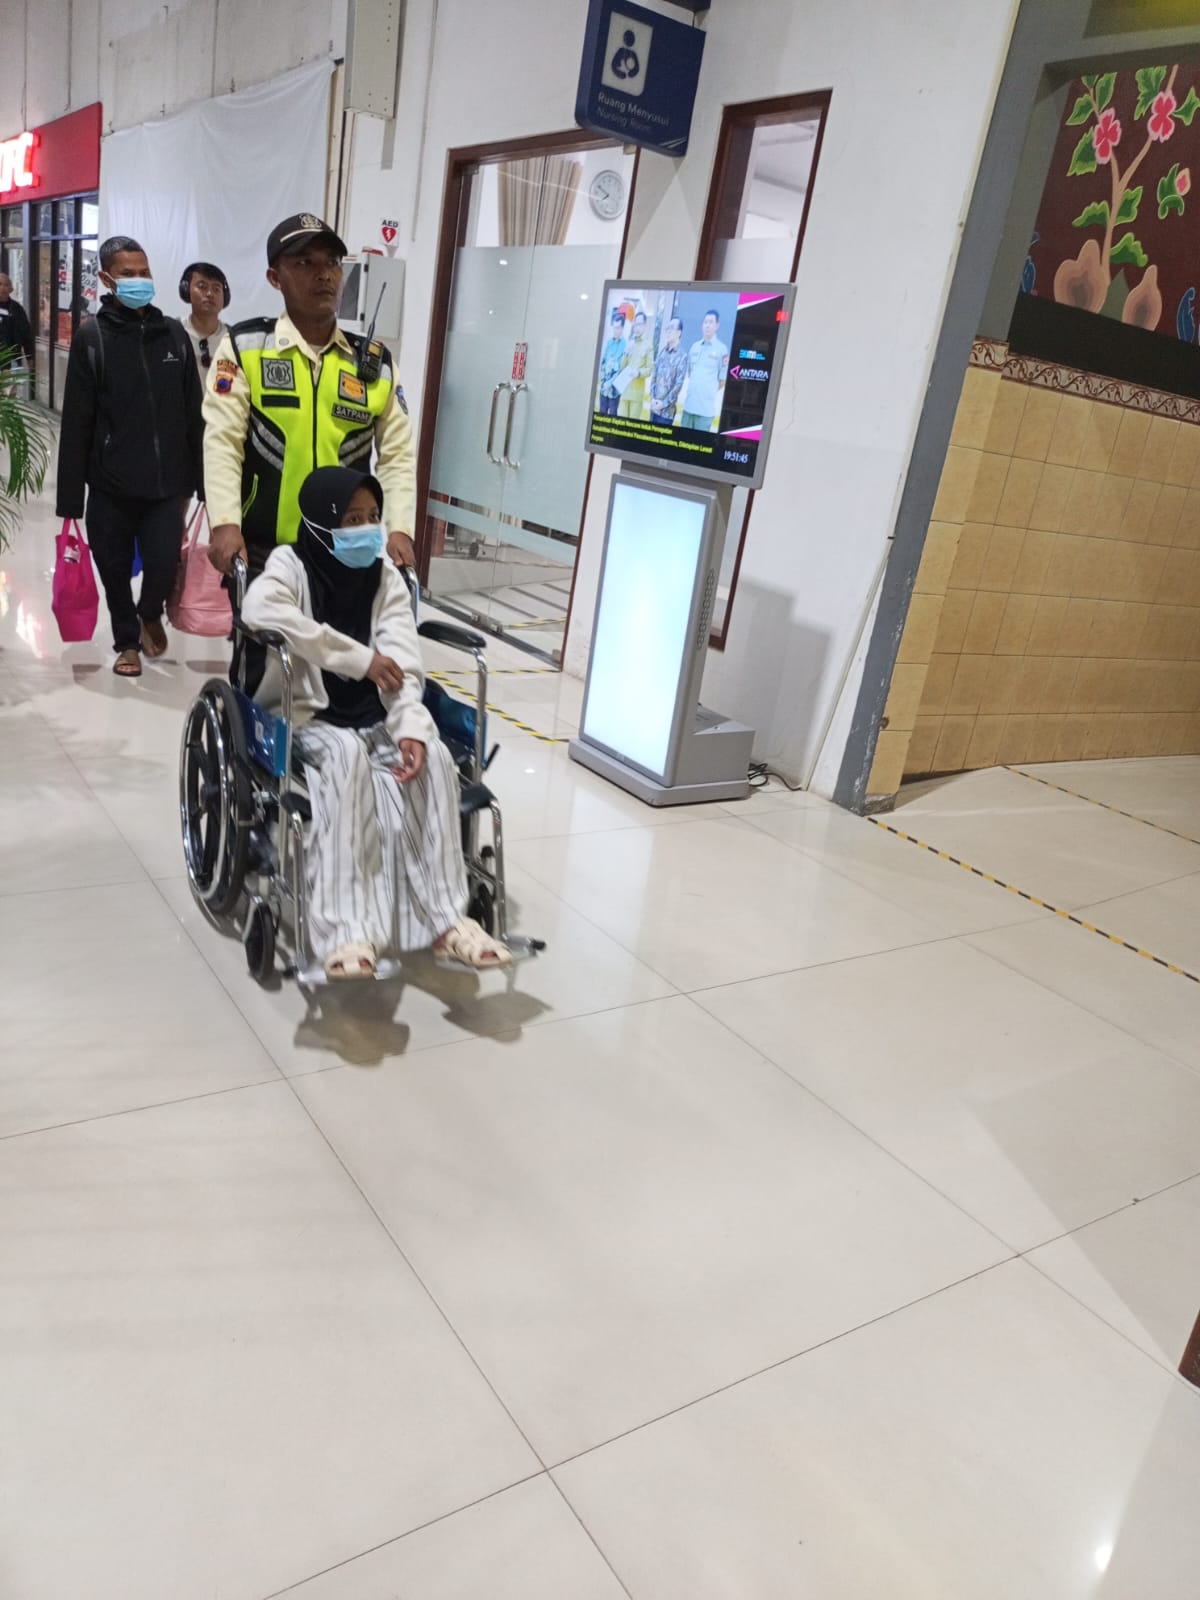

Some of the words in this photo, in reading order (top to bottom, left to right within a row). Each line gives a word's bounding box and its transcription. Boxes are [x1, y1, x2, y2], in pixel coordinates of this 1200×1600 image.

[598, 91, 626, 113] Ruang
[627, 102, 670, 127] Menyusui
[0, 131, 37, 193] FC
[382, 219, 399, 228] AED
[739, 368, 769, 379] ANTARA
[335, 405, 370, 421] SATPAM
[723, 450, 749, 464] 19:51:45
